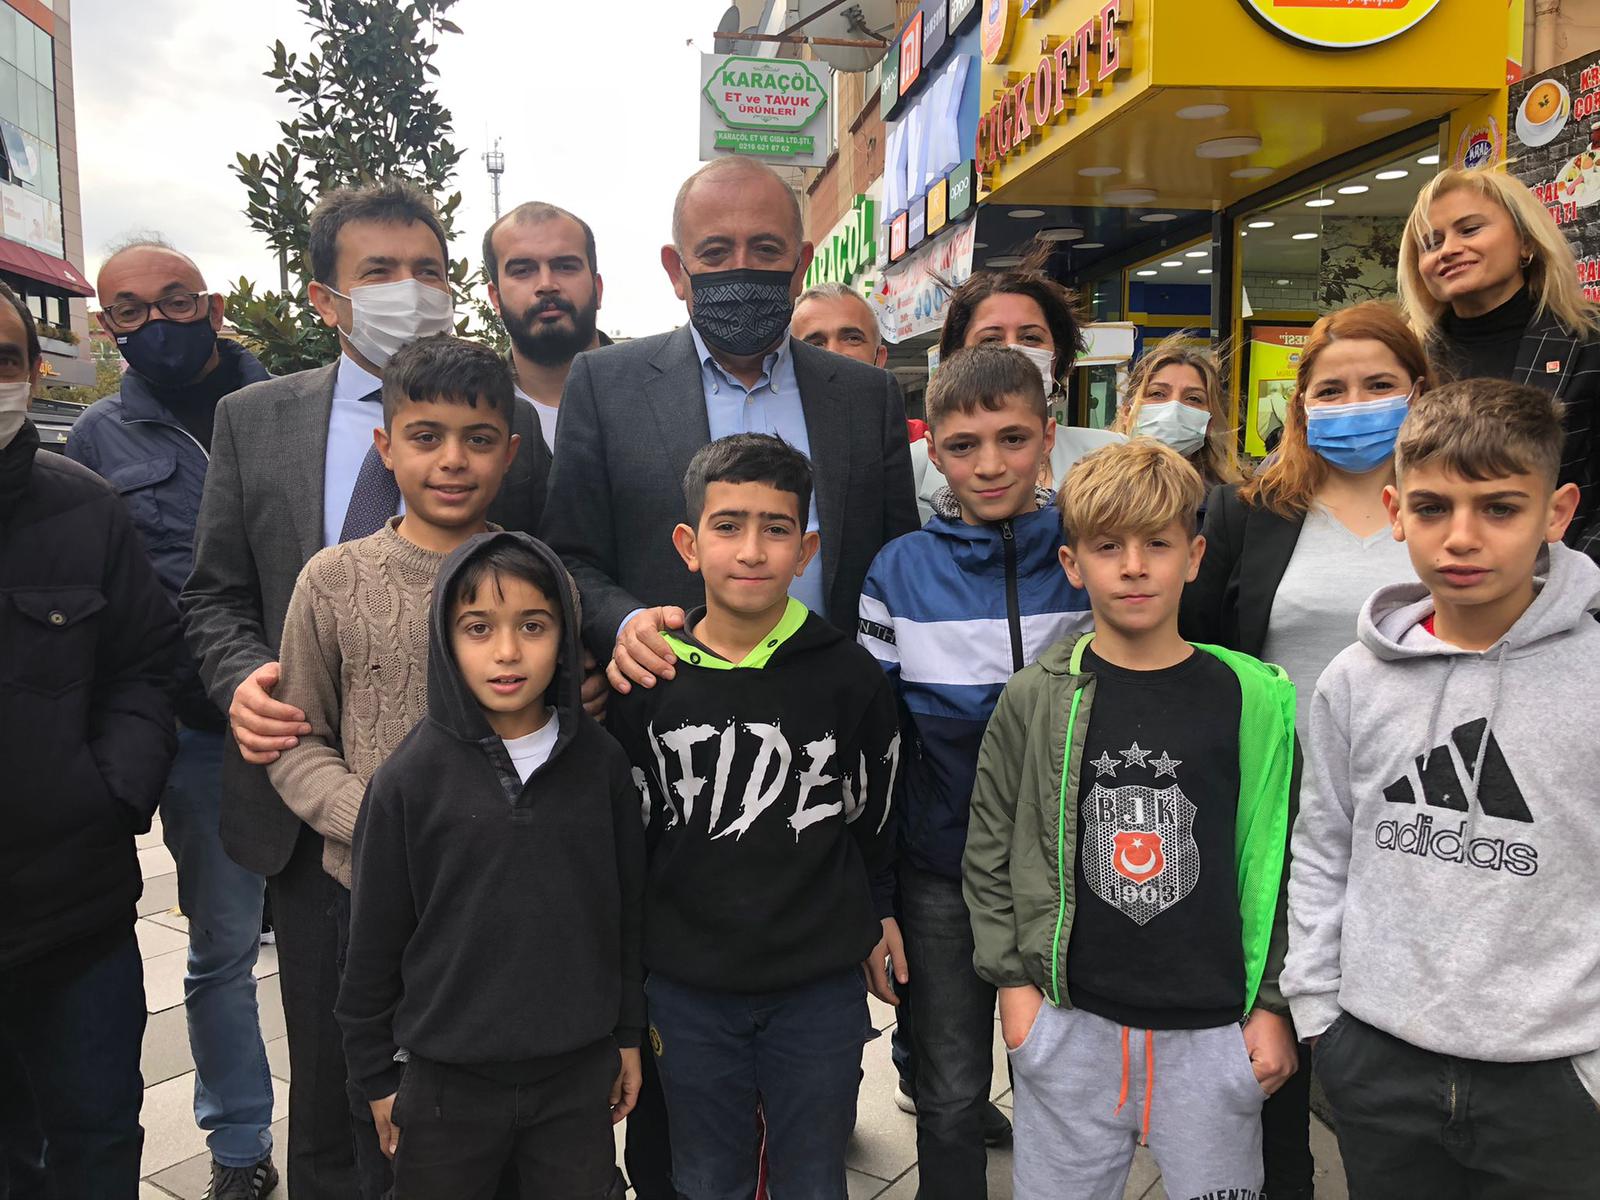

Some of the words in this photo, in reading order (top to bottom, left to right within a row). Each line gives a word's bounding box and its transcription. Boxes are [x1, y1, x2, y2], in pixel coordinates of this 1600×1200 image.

[722, 71, 816, 94] KARAÇÖL
[725, 92, 742, 102] ET
[746, 96, 760, 104] ve
[765, 95, 809, 107] TAVUK
[739, 104, 796, 116] ÜRÜNLERİ
[950, 177, 970, 200] oppo
[1099, 797, 1175, 824] BJK
[1375, 813, 1538, 877] adidas
[1107, 885, 1175, 903] 1903
